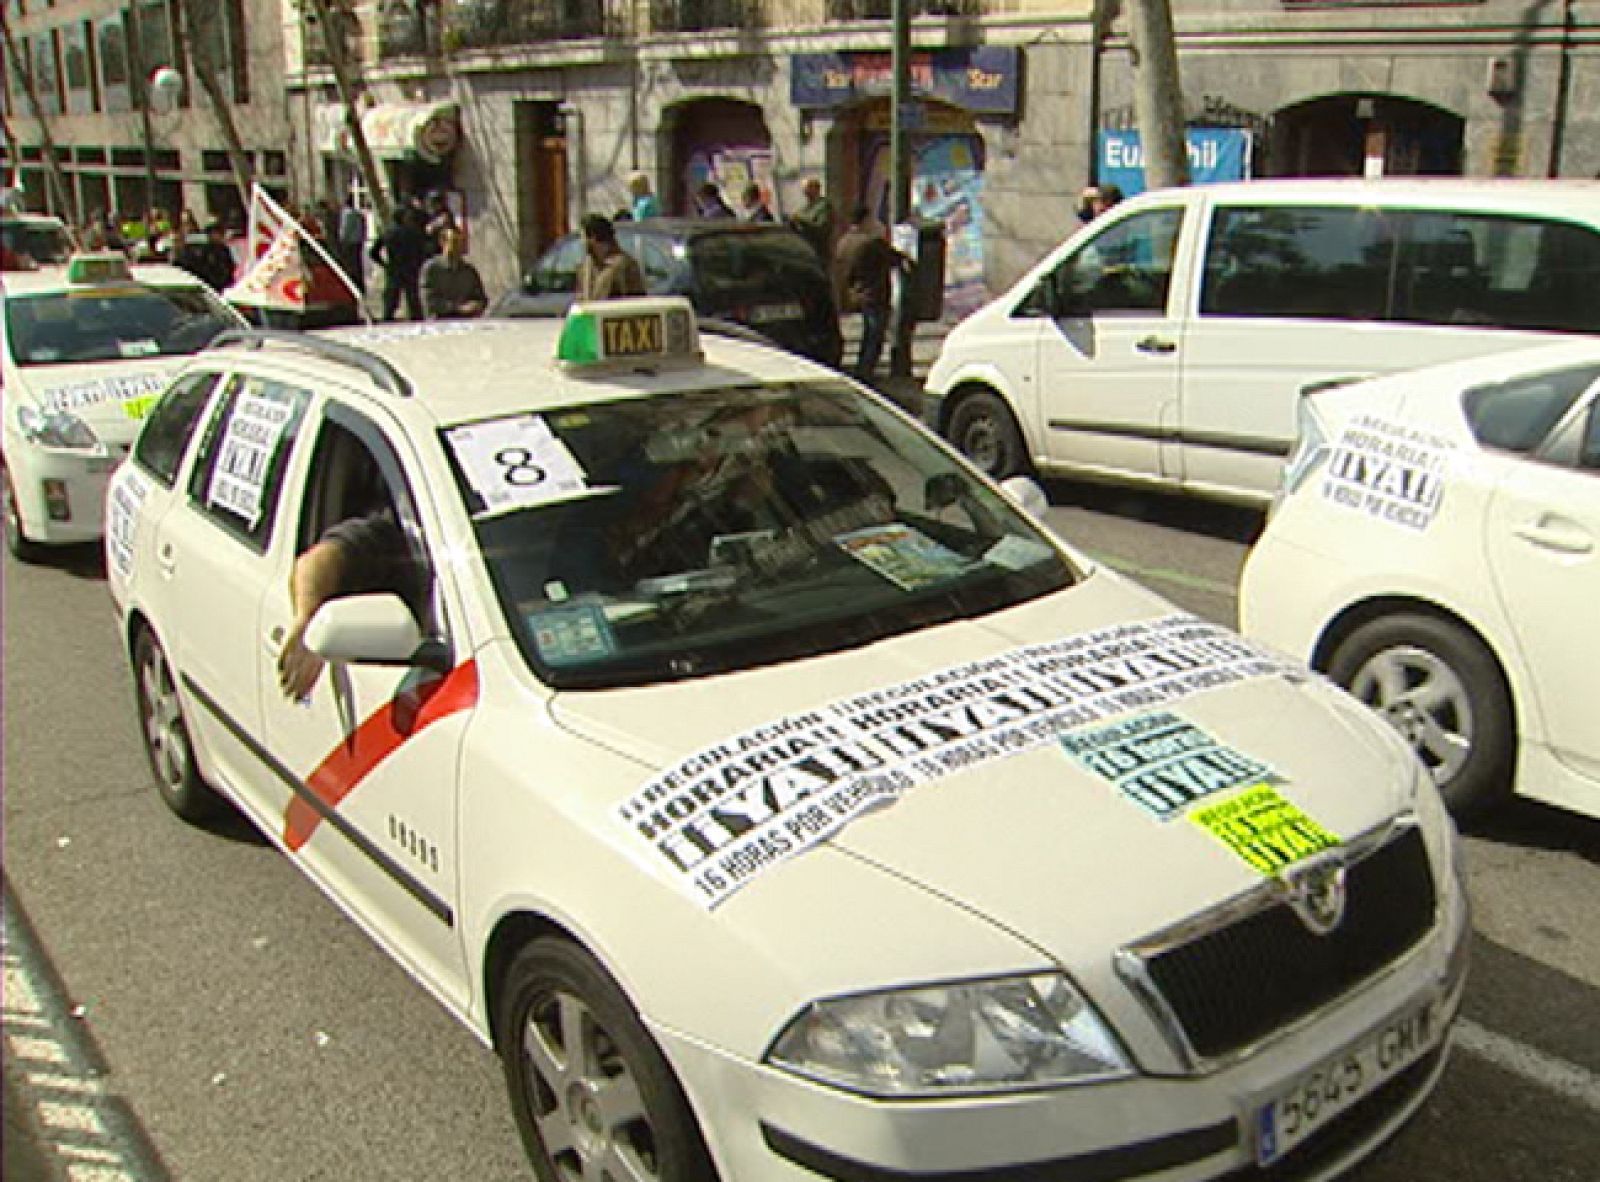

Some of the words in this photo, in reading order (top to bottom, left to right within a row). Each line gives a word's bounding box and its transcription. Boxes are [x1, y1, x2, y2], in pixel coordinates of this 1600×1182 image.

[606, 318, 662, 354] TAXI
[495, 448, 546, 486] 8
[694, 867, 727, 896] 16
[718, 829, 793, 881] HORAS
